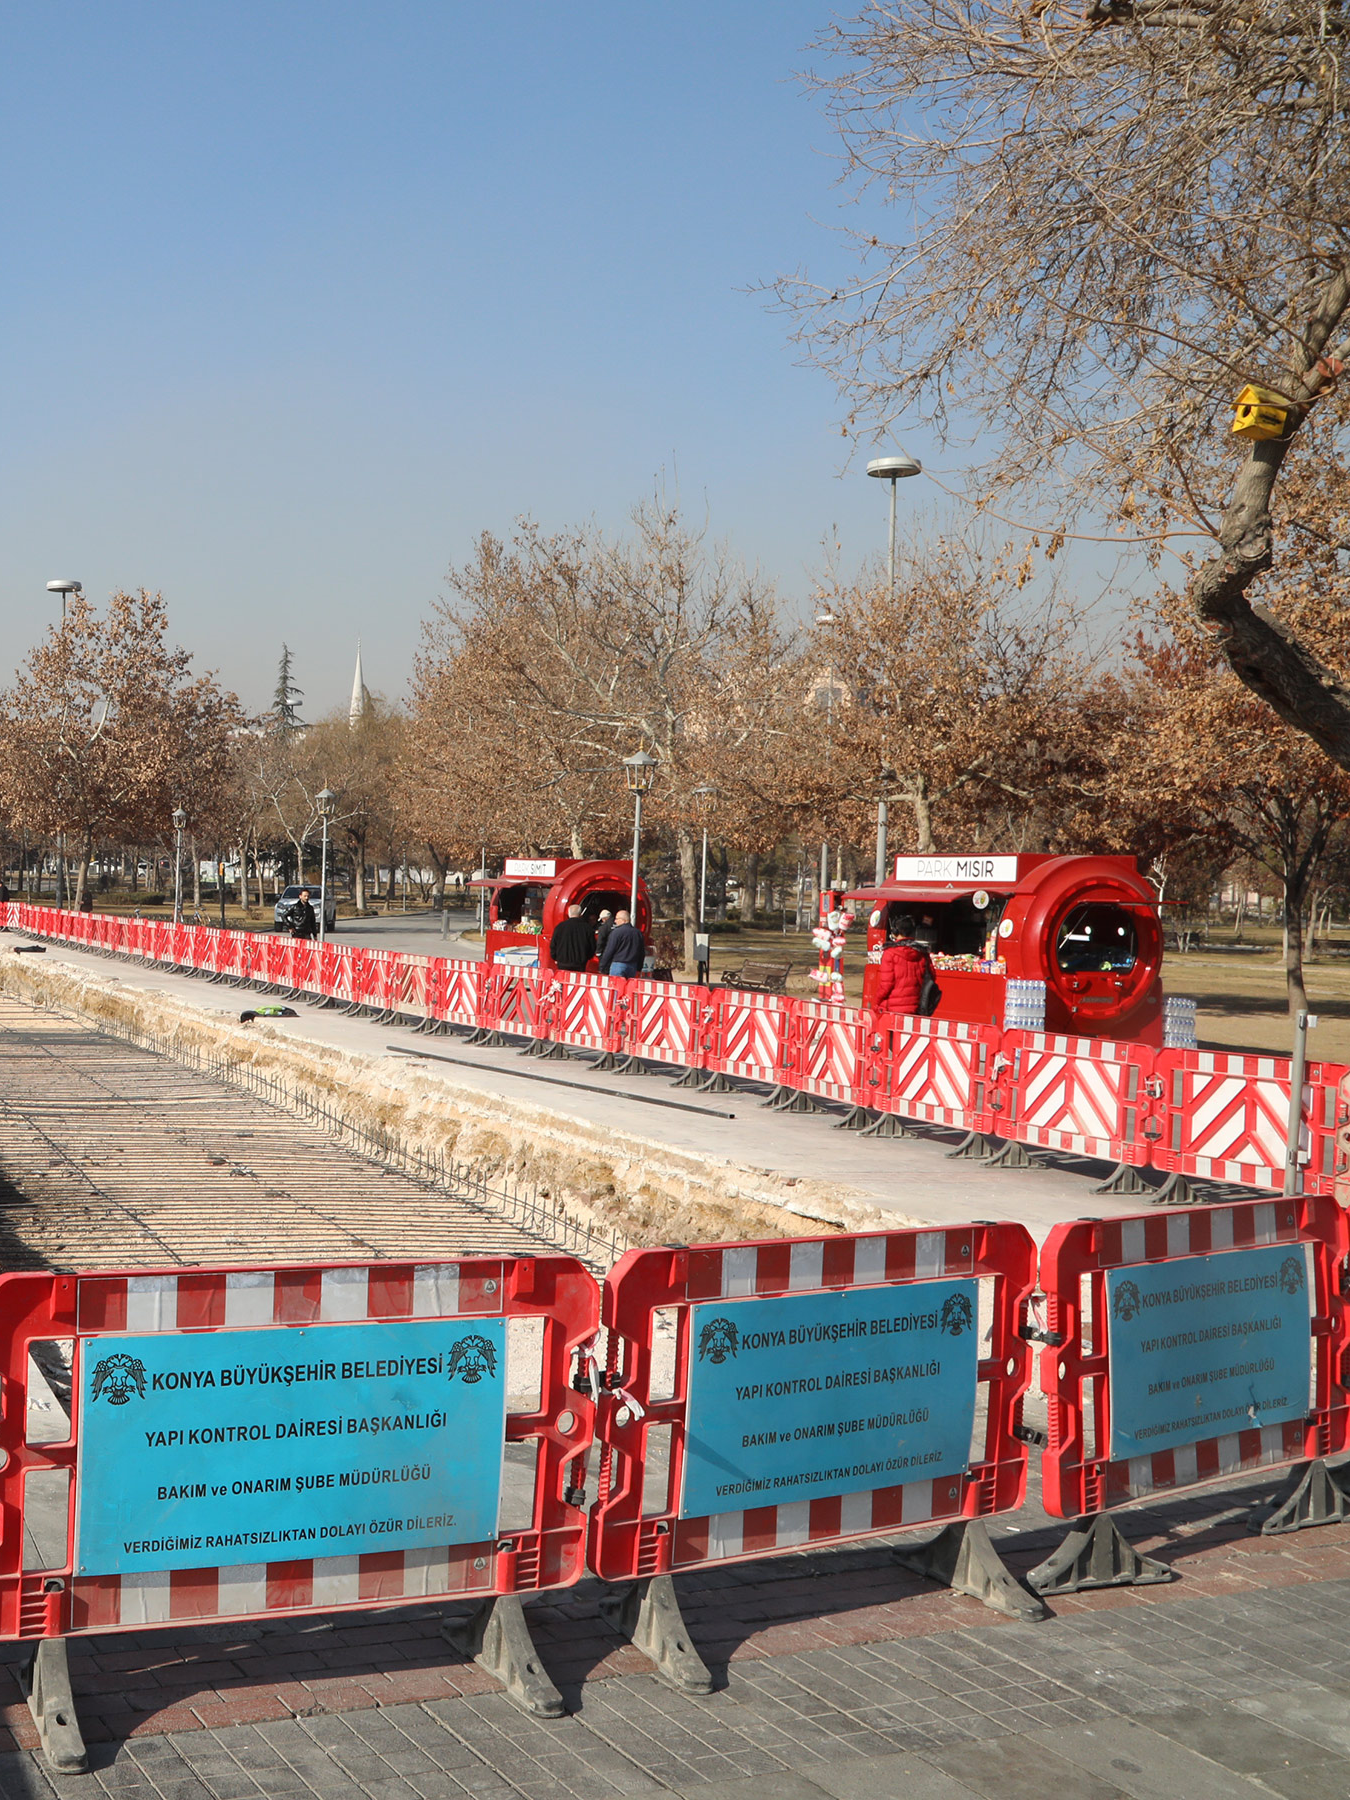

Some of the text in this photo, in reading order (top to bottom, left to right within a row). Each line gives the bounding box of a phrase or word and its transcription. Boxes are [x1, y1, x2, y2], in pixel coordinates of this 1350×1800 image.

[917, 859, 994, 878] PARK MISIR
[1142, 1272, 1279, 1308] KONYA BÜYÜKŞEHİR BELEDİYESİ
[742, 1310, 938, 1350] KONYA BÜYÜKŞEHİR BELEDİYESİ
[1141, 1315, 1282, 1352] YAPI KONTROL DAİRESİ BAŞKANLIĞI
[152, 1353, 442, 1390] KONYA BÜYÜKŞEHİR BELEDİYESİ
[736, 1360, 940, 1400] YAPI KONTROL DAİRESİ BAŞKANLIĞI
[1149, 1379, 1171, 1395] BAKIM
[1182, 1373, 1208, 1388] ONARIM
[1209, 1368, 1229, 1383] ŞUBE
[1230, 1359, 1275, 1378] MÜDÜRLÜĞÜ
[145, 1409, 446, 1447] YAPI KONTROL DAİRESİ BAŞKANLIĞI
[742, 1408, 929, 1447] BAKIM ve ONARIM ŞUBE MÜDÜRLÜĞÜ
[1134, 1421, 1171, 1439] VERDİĞİMİZ
[1172, 1412, 1223, 1429] RAHATSIZLIKTAN
[1223, 1406, 1245, 1420] DOLAYI
[1245, 1400, 1261, 1415] ÖR
[157, 1464, 430, 1500] BAKIM ve ONARIM ŞUBE MÜDÜRLÜĞÜ
[716, 1478, 771, 1496] VERDİĞİMİZ
[774, 1467, 850, 1488] RAHATSIZLIKTAN
[852, 1462, 883, 1476] DOLAYI
[886, 1456, 908, 1470] ÖZÜR
[124, 1516, 456, 1553] VERDİĞİMİZ RAHATSIZLIKTAN DOLAYI ÖZÜR DİLERİZ.
